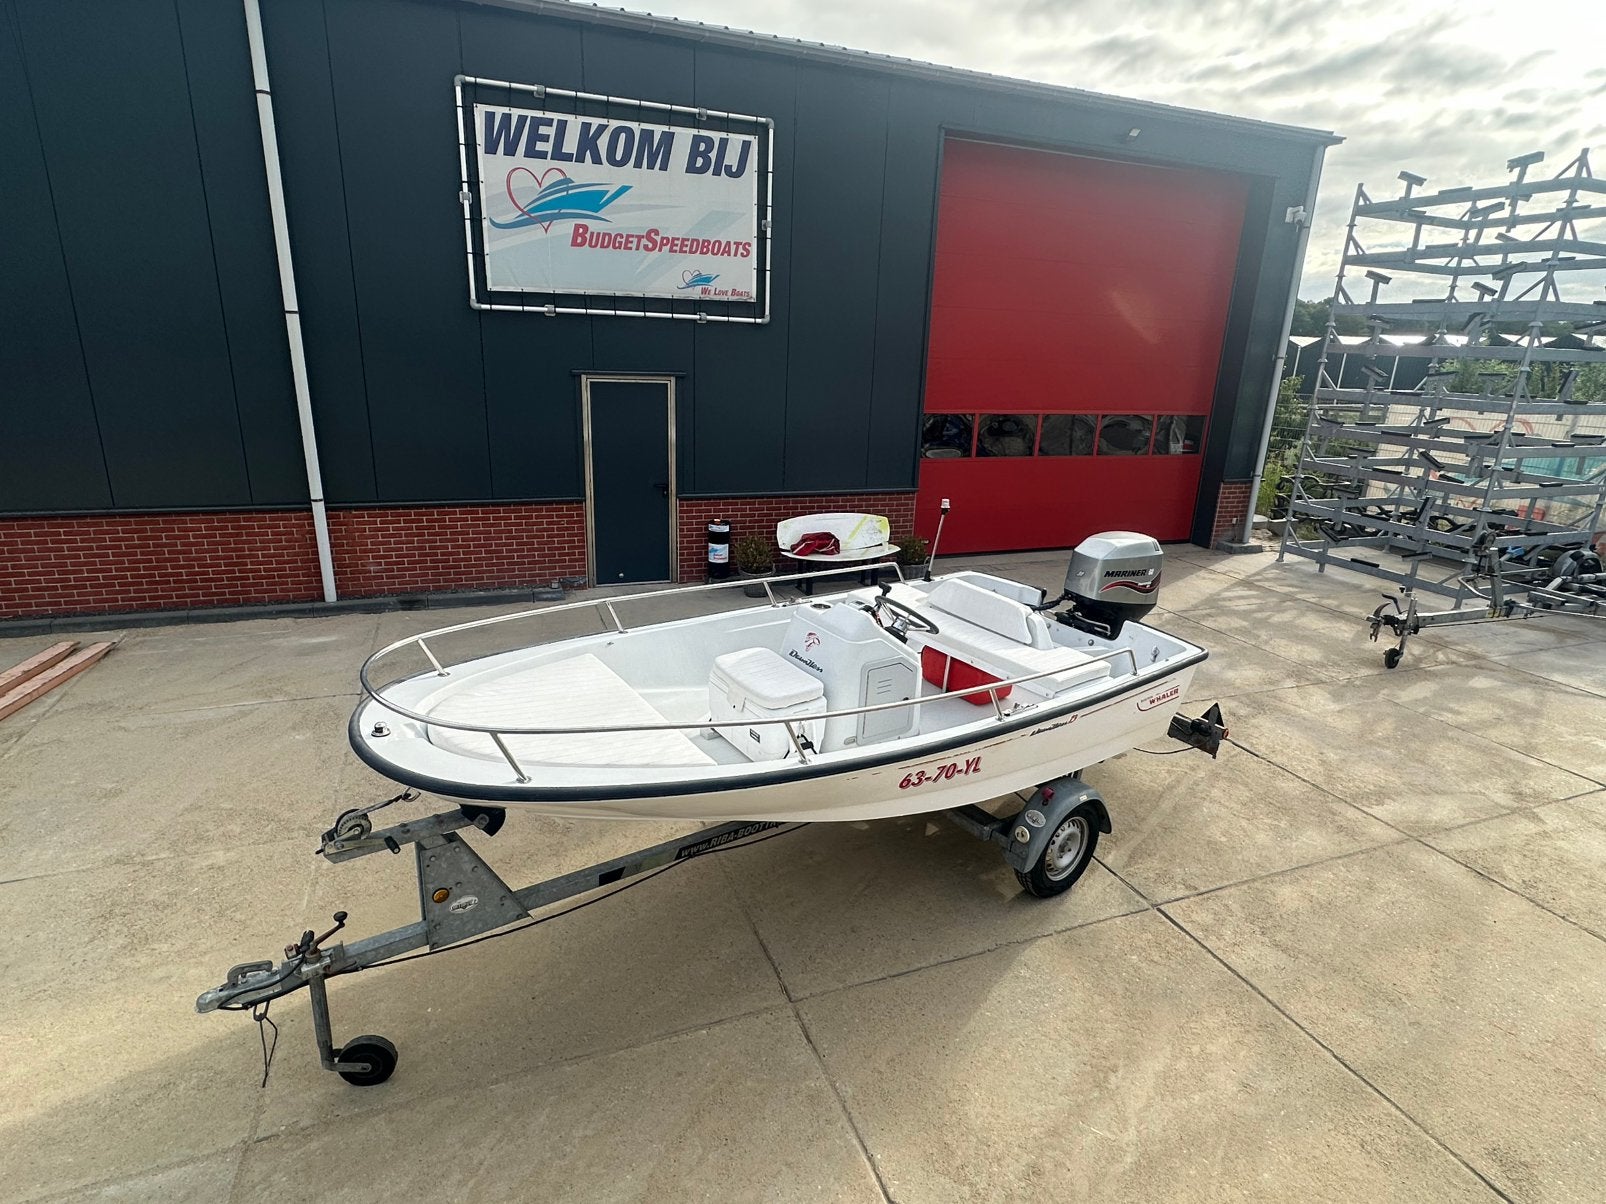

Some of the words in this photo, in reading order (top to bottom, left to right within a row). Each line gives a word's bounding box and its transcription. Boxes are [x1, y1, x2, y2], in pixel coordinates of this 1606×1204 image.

[483, 110, 675, 172] WELKOM
[685, 134, 752, 179] BIJ
[1103, 568, 1147, 578] MARINER
[1149, 687, 1179, 705] WHALER
[898, 756, 982, 790] 63-70-YL
